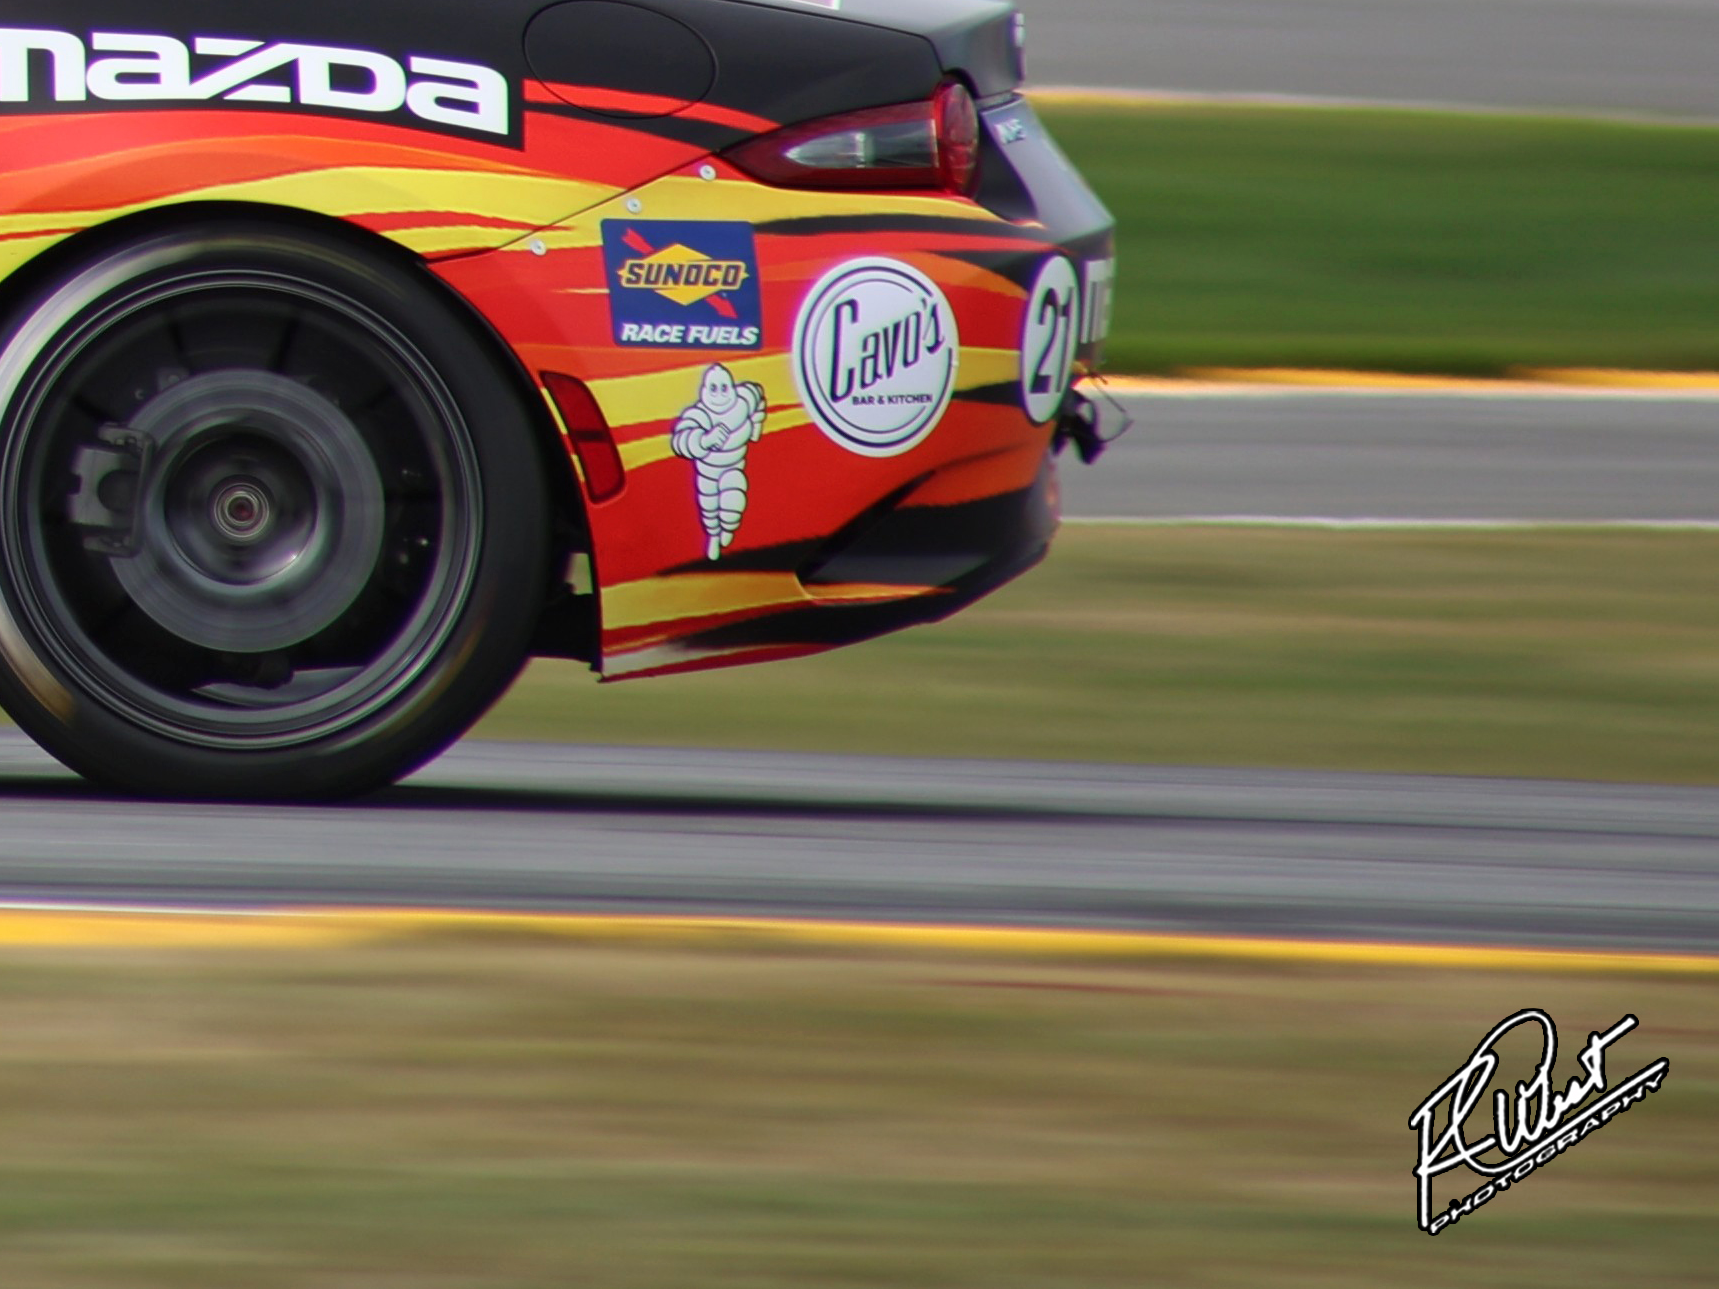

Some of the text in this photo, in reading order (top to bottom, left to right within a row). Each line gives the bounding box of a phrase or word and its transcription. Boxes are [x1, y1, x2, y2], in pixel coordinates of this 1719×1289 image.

[624, 261, 743, 288] SUNOCO
[621, 323, 760, 345] RACE FUELS
[1029, 286, 1074, 395] 21
[829, 297, 945, 403] Cavo's
[852, 393, 933, 405] BAR & KITCHEN
